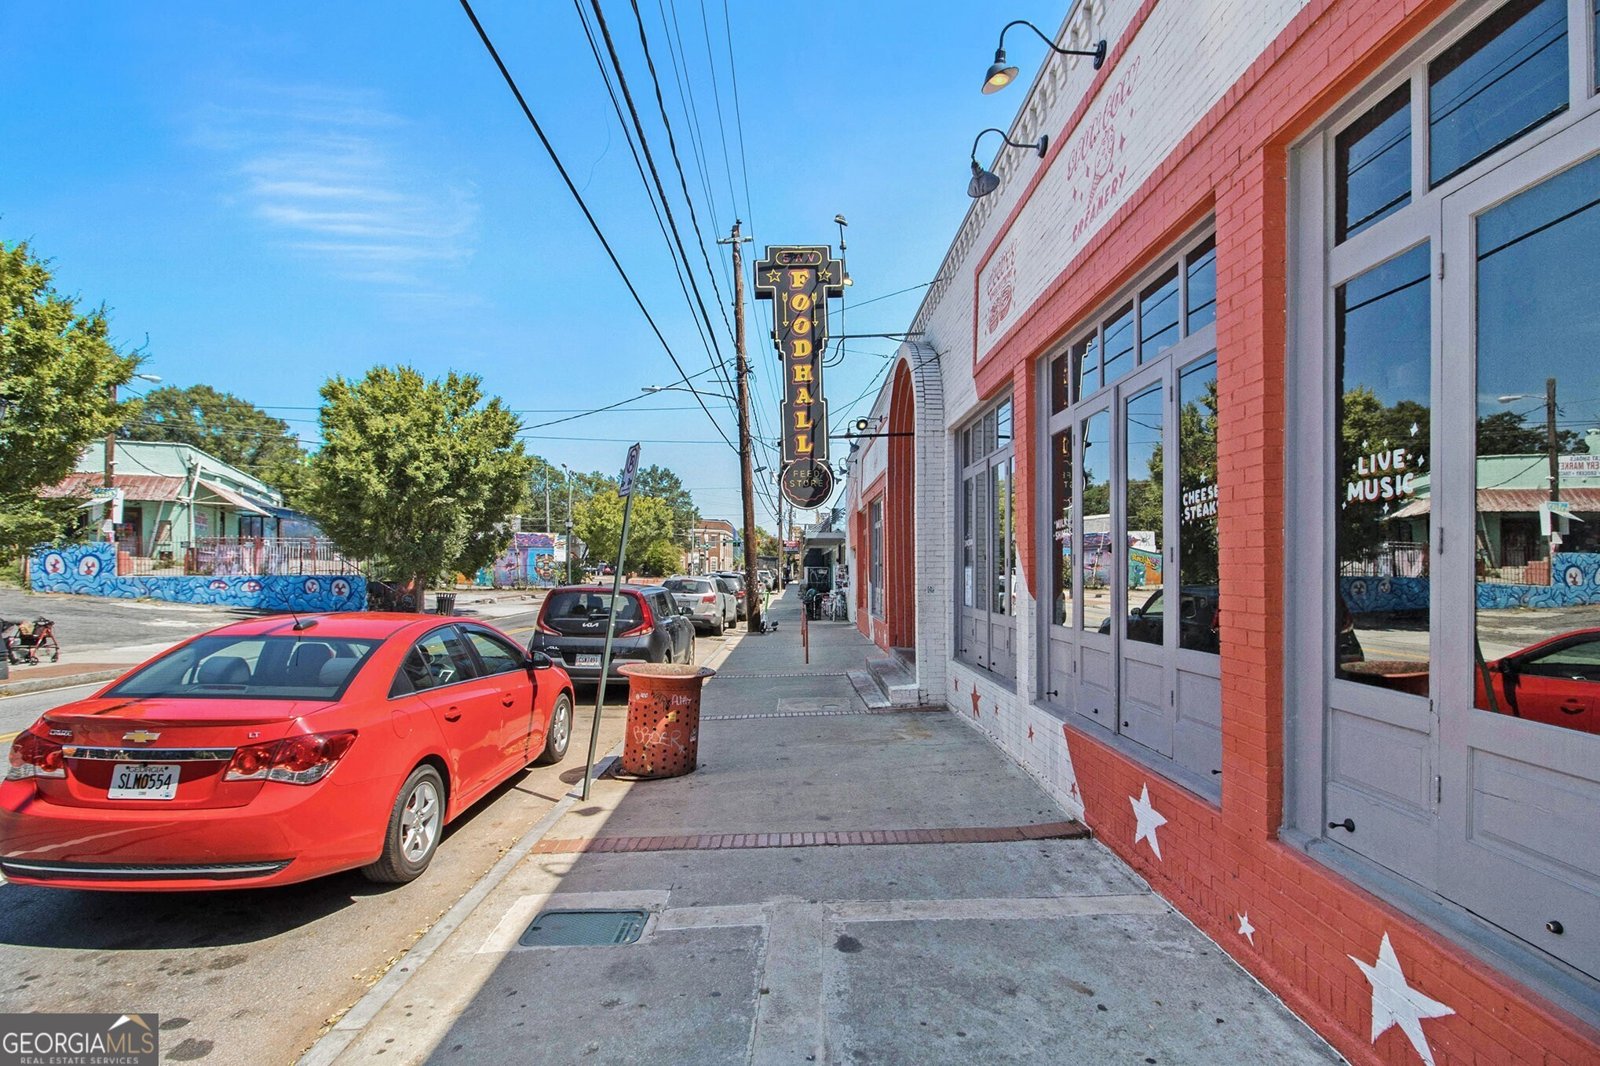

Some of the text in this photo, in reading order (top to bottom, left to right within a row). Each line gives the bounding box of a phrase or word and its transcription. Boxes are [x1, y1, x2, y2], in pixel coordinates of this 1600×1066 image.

[1072, 165, 1127, 243] CREAMERY
[1358, 448, 1406, 476] LIVE
[789, 480, 824, 488] STORE
[793, 470, 820, 478] FEED
[1183, 484, 1219, 506] CHEESE
[1347, 472, 1414, 502] MUSIC
[1184, 500, 1219, 520] STEAK
